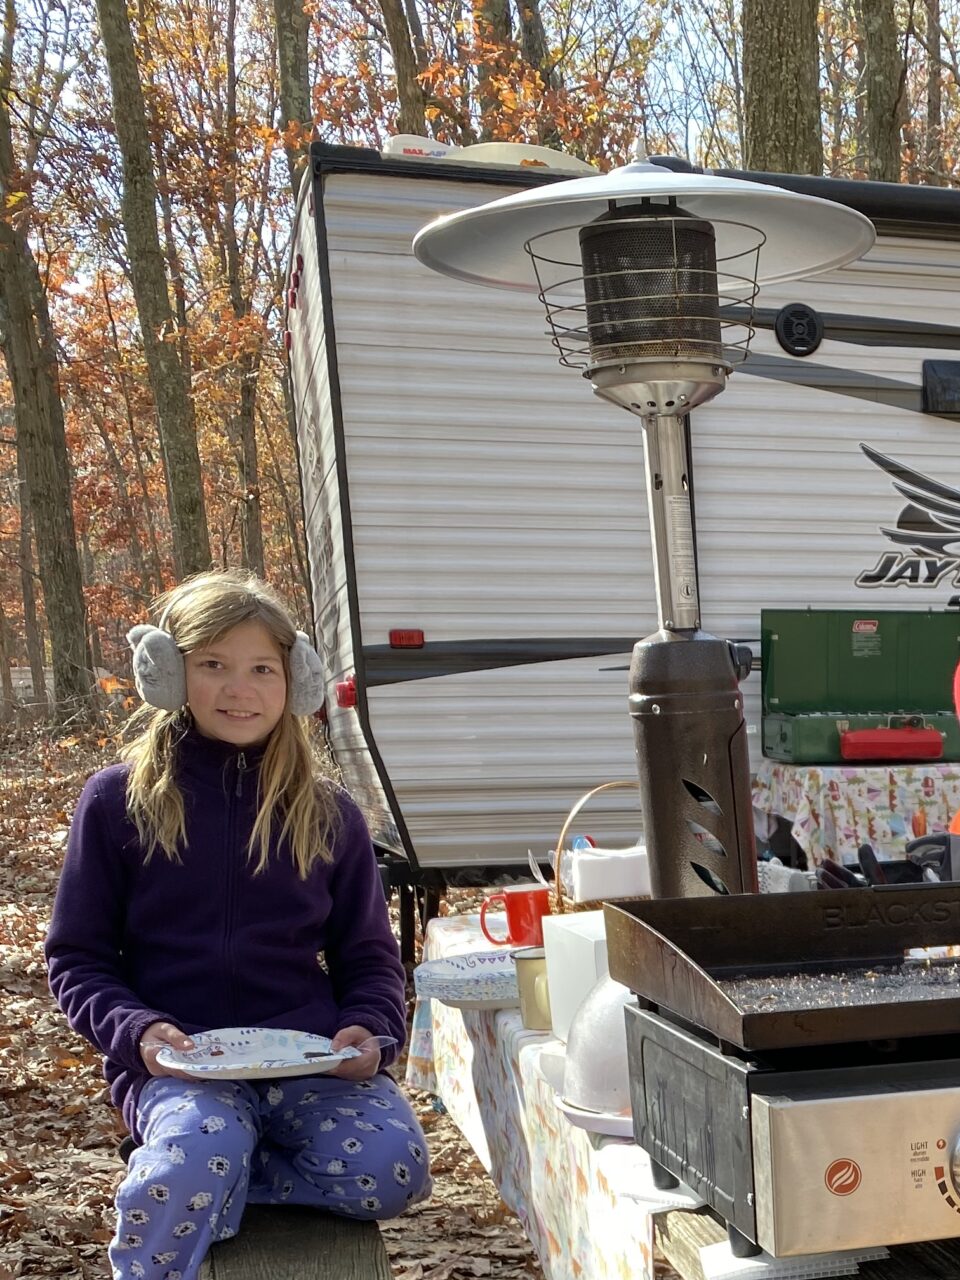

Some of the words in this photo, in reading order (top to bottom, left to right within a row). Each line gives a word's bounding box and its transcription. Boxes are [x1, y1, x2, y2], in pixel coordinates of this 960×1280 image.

[857, 553, 959, 588] JAY
[910, 1141, 928, 1150] LIGHT
[911, 1169, 927, 1178] HIGH
